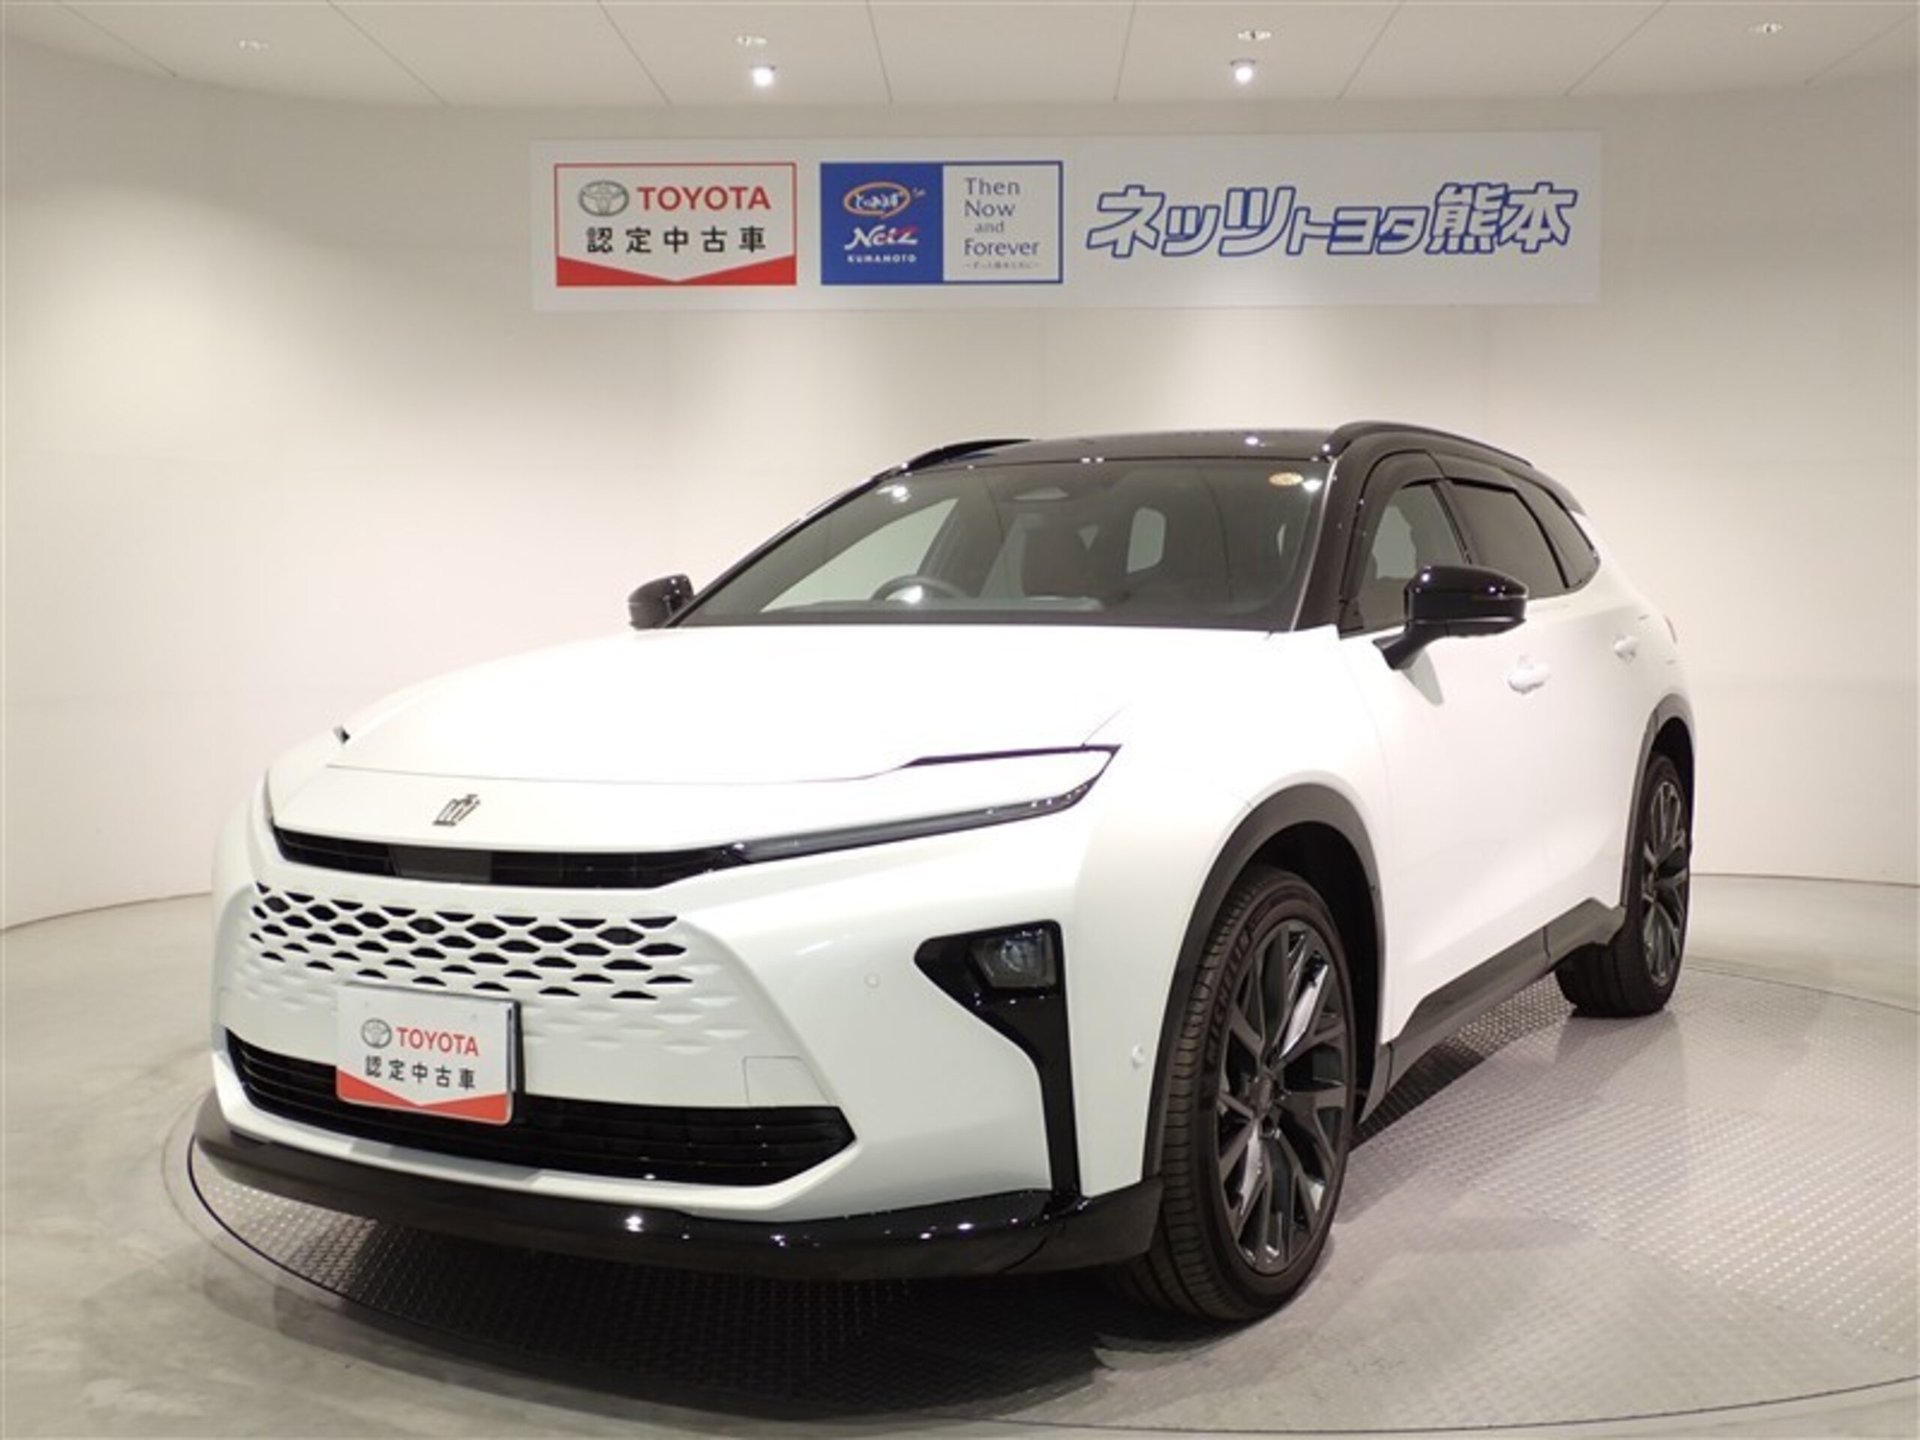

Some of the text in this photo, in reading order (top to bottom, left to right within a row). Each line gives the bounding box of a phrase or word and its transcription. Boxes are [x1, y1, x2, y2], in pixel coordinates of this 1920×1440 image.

[964, 176, 1021, 196] Then
[637, 186, 771, 210] TOYOTA
[964, 199, 1016, 218] Now
[974, 220, 1005, 234] and
[1086, 182, 1578, 258] ネッツトヨタ熊本
[586, 226, 767, 254] 認定中古車
[963, 238, 1040, 257] Forever
[846, 253, 918, 263] KUMAMOTO
[396, 1026, 479, 1057] TOYOTA
[365, 1054, 476, 1091] 認定中古車
